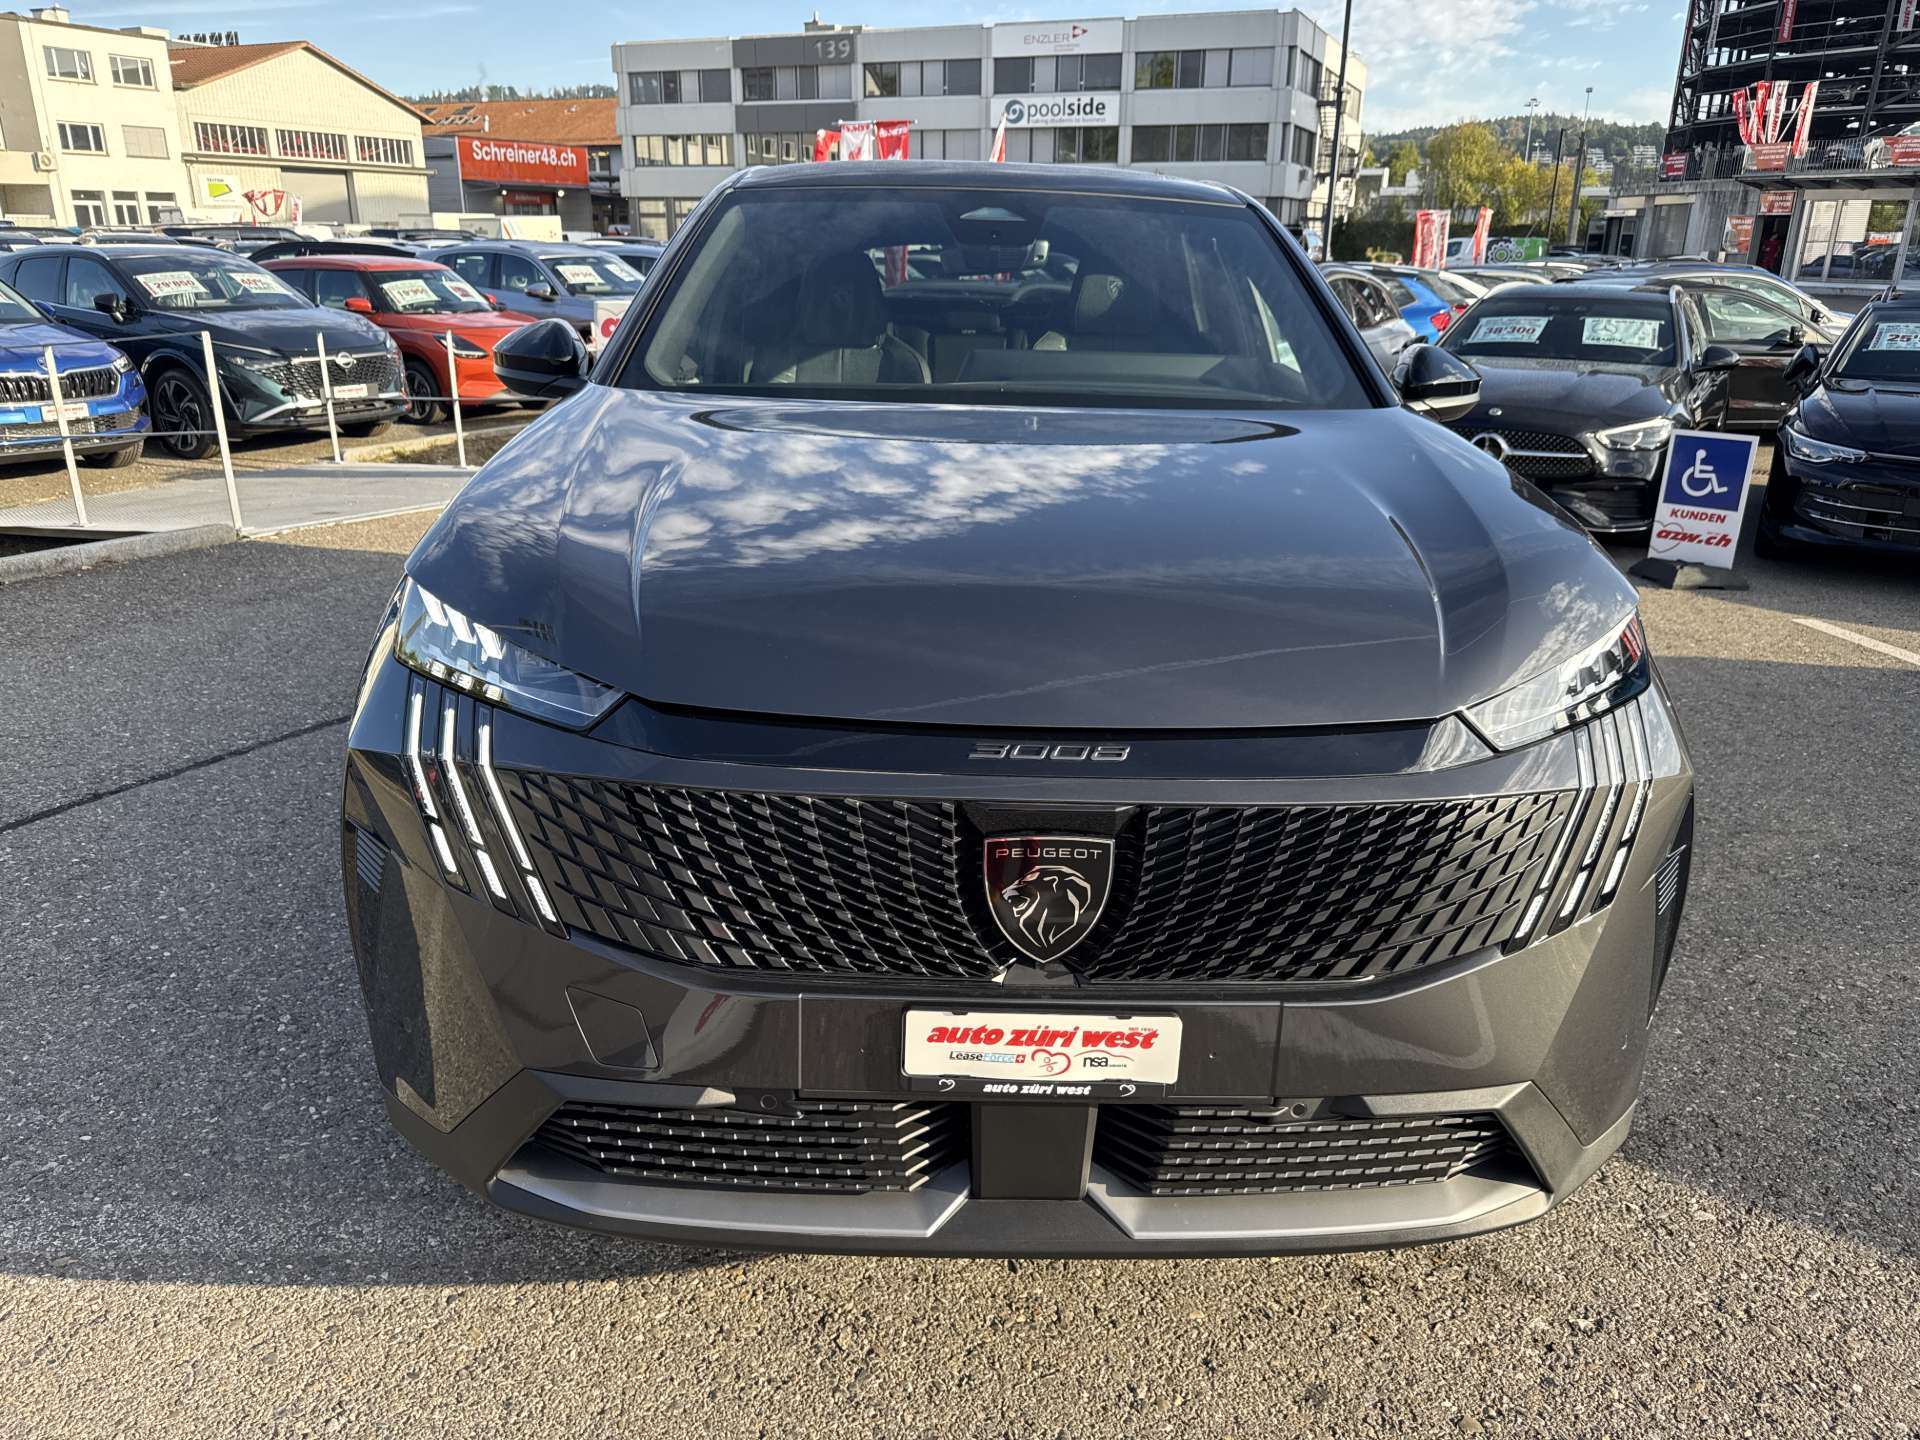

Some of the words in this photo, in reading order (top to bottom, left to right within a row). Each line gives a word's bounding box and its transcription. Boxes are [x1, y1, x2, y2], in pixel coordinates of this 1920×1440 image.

[1023, 32, 1071, 45] ENZLER
[814, 39, 850, 59] 139
[1027, 97, 1106, 124] poolside
[472, 140, 577, 167] Schreiner48.ch
[1670, 508, 1727, 524] KUNDEN
[1656, 529, 1732, 548] azw.ch
[968, 743, 1131, 762] 3008
[995, 848, 1102, 860] PEUGEOT
[926, 1024, 1004, 1045] auto
[1006, 1024, 1080, 1048] züri
[1081, 1027, 1160, 1050] west
[1083, 1056, 1109, 1068] nsa
[983, 1083, 1017, 1094] auto
[1020, 1082, 1053, 1095] züri
[1056, 1084, 1091, 1096] west
